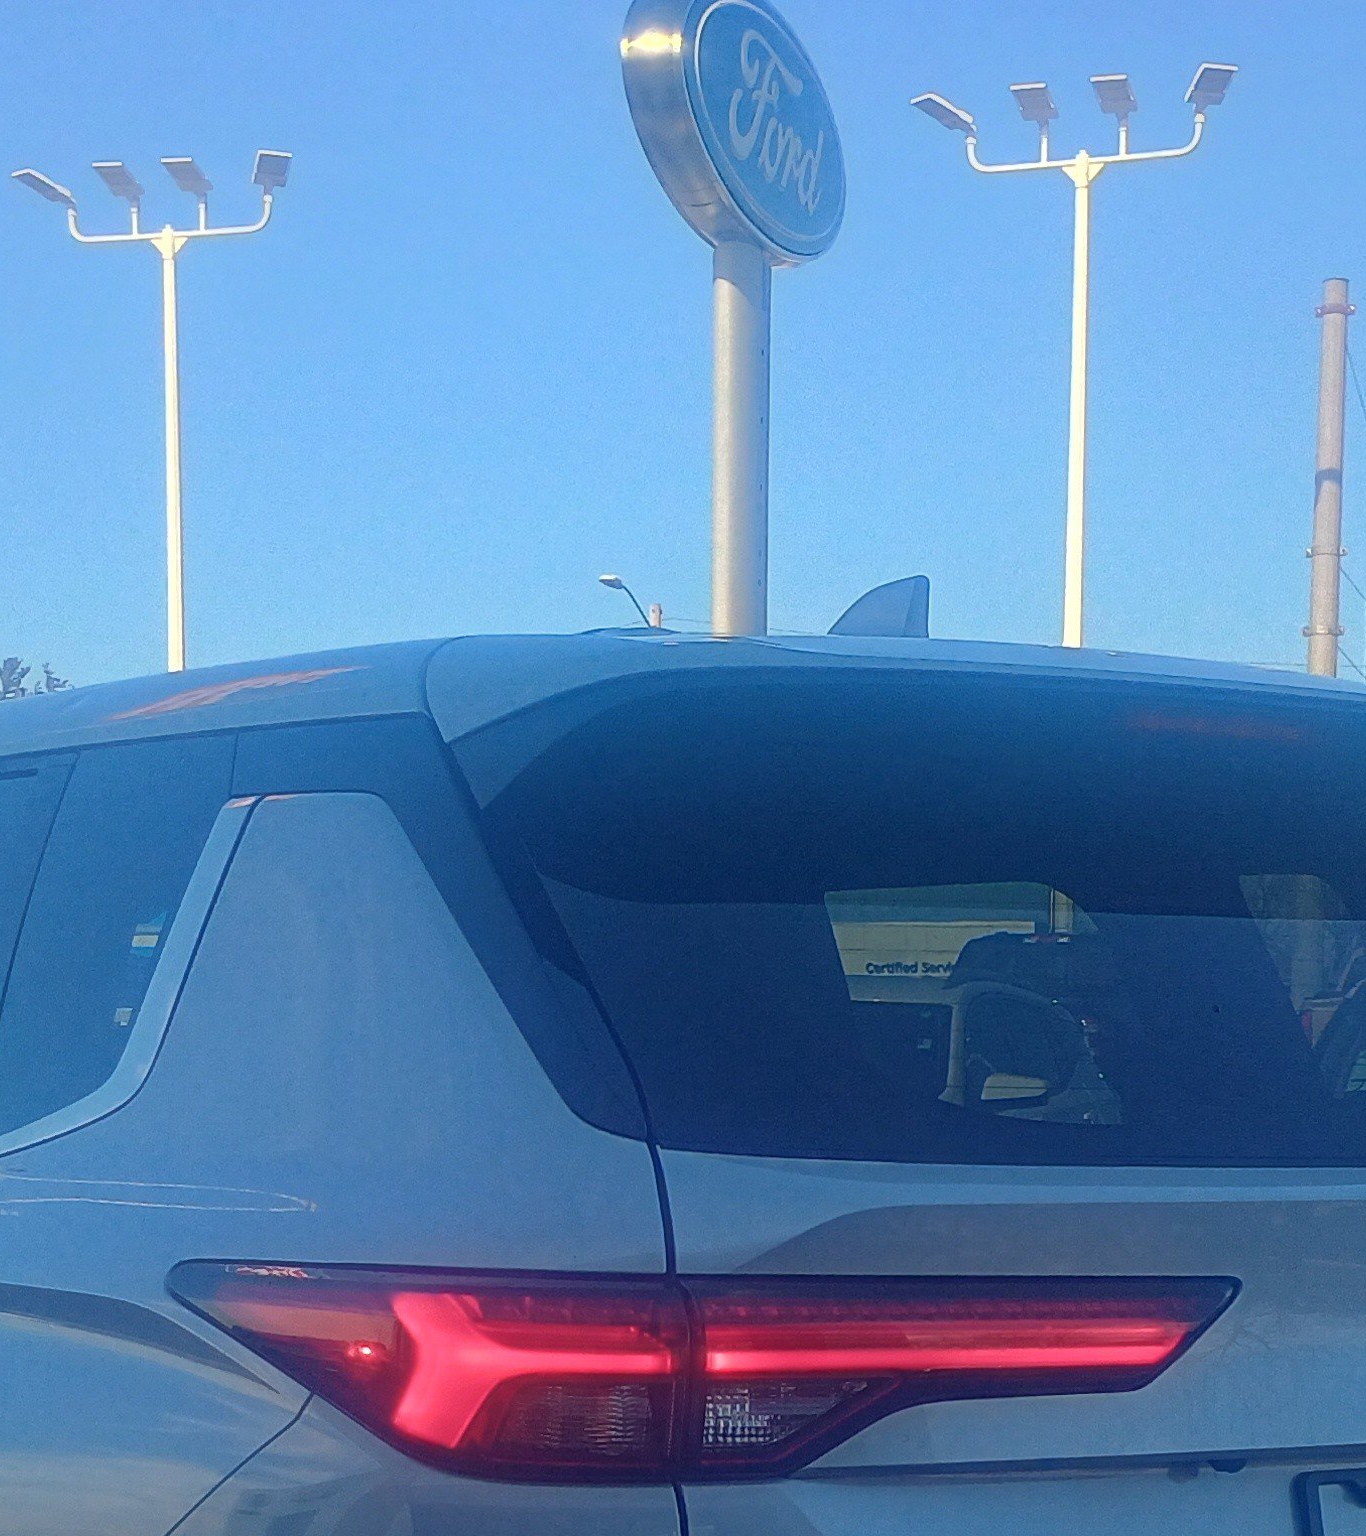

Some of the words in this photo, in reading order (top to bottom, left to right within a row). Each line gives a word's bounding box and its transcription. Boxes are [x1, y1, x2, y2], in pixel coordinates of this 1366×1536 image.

[729, 28, 823, 216] Ford
[865, 961, 918, 975] Certified
[922, 961, 954, 974] Servi
